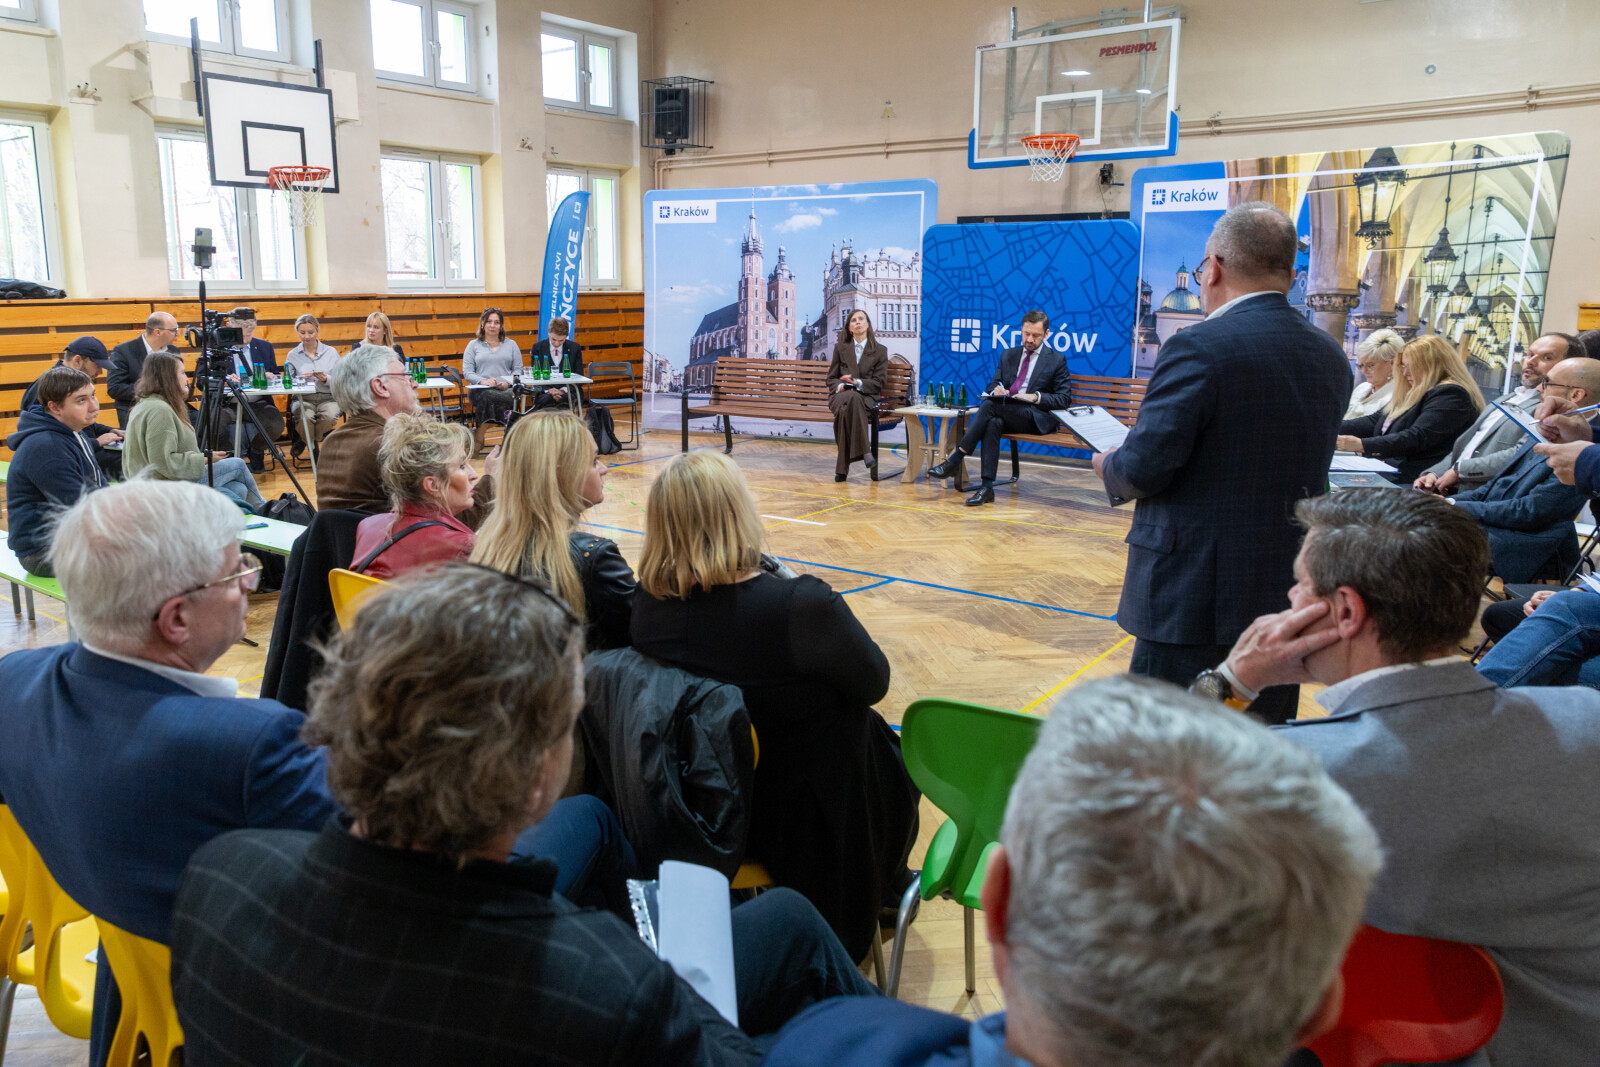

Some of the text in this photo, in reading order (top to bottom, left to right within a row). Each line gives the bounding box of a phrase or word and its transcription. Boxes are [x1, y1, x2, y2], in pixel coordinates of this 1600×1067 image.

[1098, 41, 1158, 57] PESMENPOL
[1170, 187, 1219, 203] Kraków
[673, 205, 710, 217] Kraków
[559, 228, 579, 339] ŃCZYCE
[551, 272, 560, 319] ZIELNICA
[991, 322, 1098, 353] Krów
